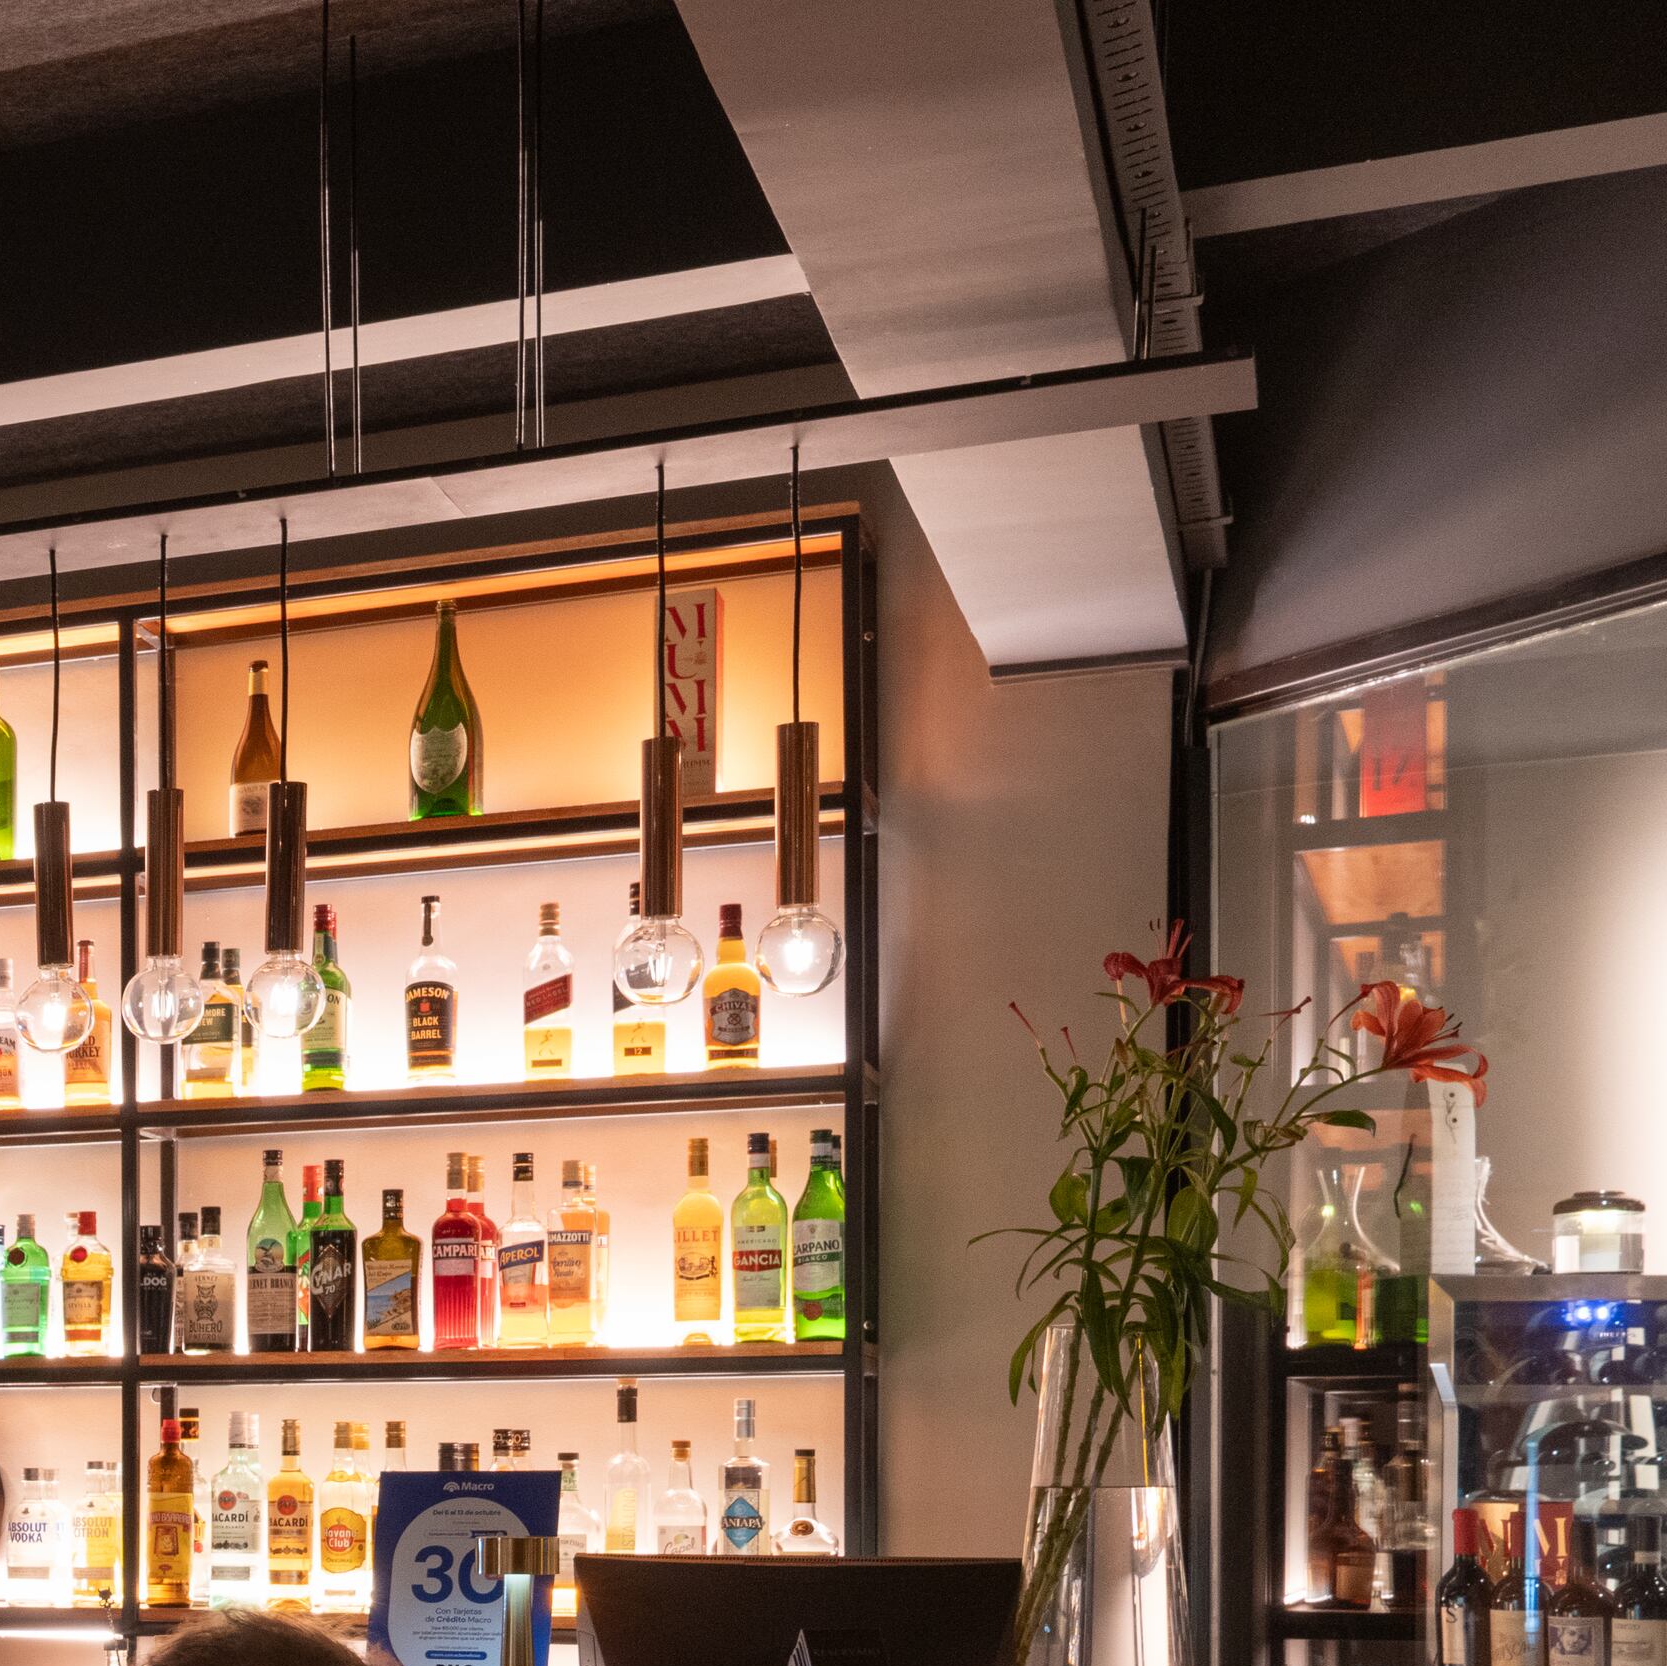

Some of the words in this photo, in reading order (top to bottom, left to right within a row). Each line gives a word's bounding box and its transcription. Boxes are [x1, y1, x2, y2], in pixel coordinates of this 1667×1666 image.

[405, 987, 450, 1002] JAMESON
[412, 1016, 439, 1027] BLACK
[411, 1029, 442, 1040] BARREL
[433, 1244, 478, 1258] CAMPARI
[500, 1247, 540, 1266] APEROL
[733, 1254, 781, 1266] GANCIA
[798, 1254, 828, 1264] BIANCO
[324, 1285, 336, 1295] 70
[461, 1481, 495, 1491] Macro
[8, 1522, 48, 1533] ABSOLUT
[9, 1532, 43, 1543] VODKA
[328, 1538, 350, 1548] Club
[435, 1607, 451, 1615] Con
[453, 1607, 482, 1617] Tarjetas
[436, 1615, 467, 1623] Crédito
[468, 1616, 492, 1624] Macro
